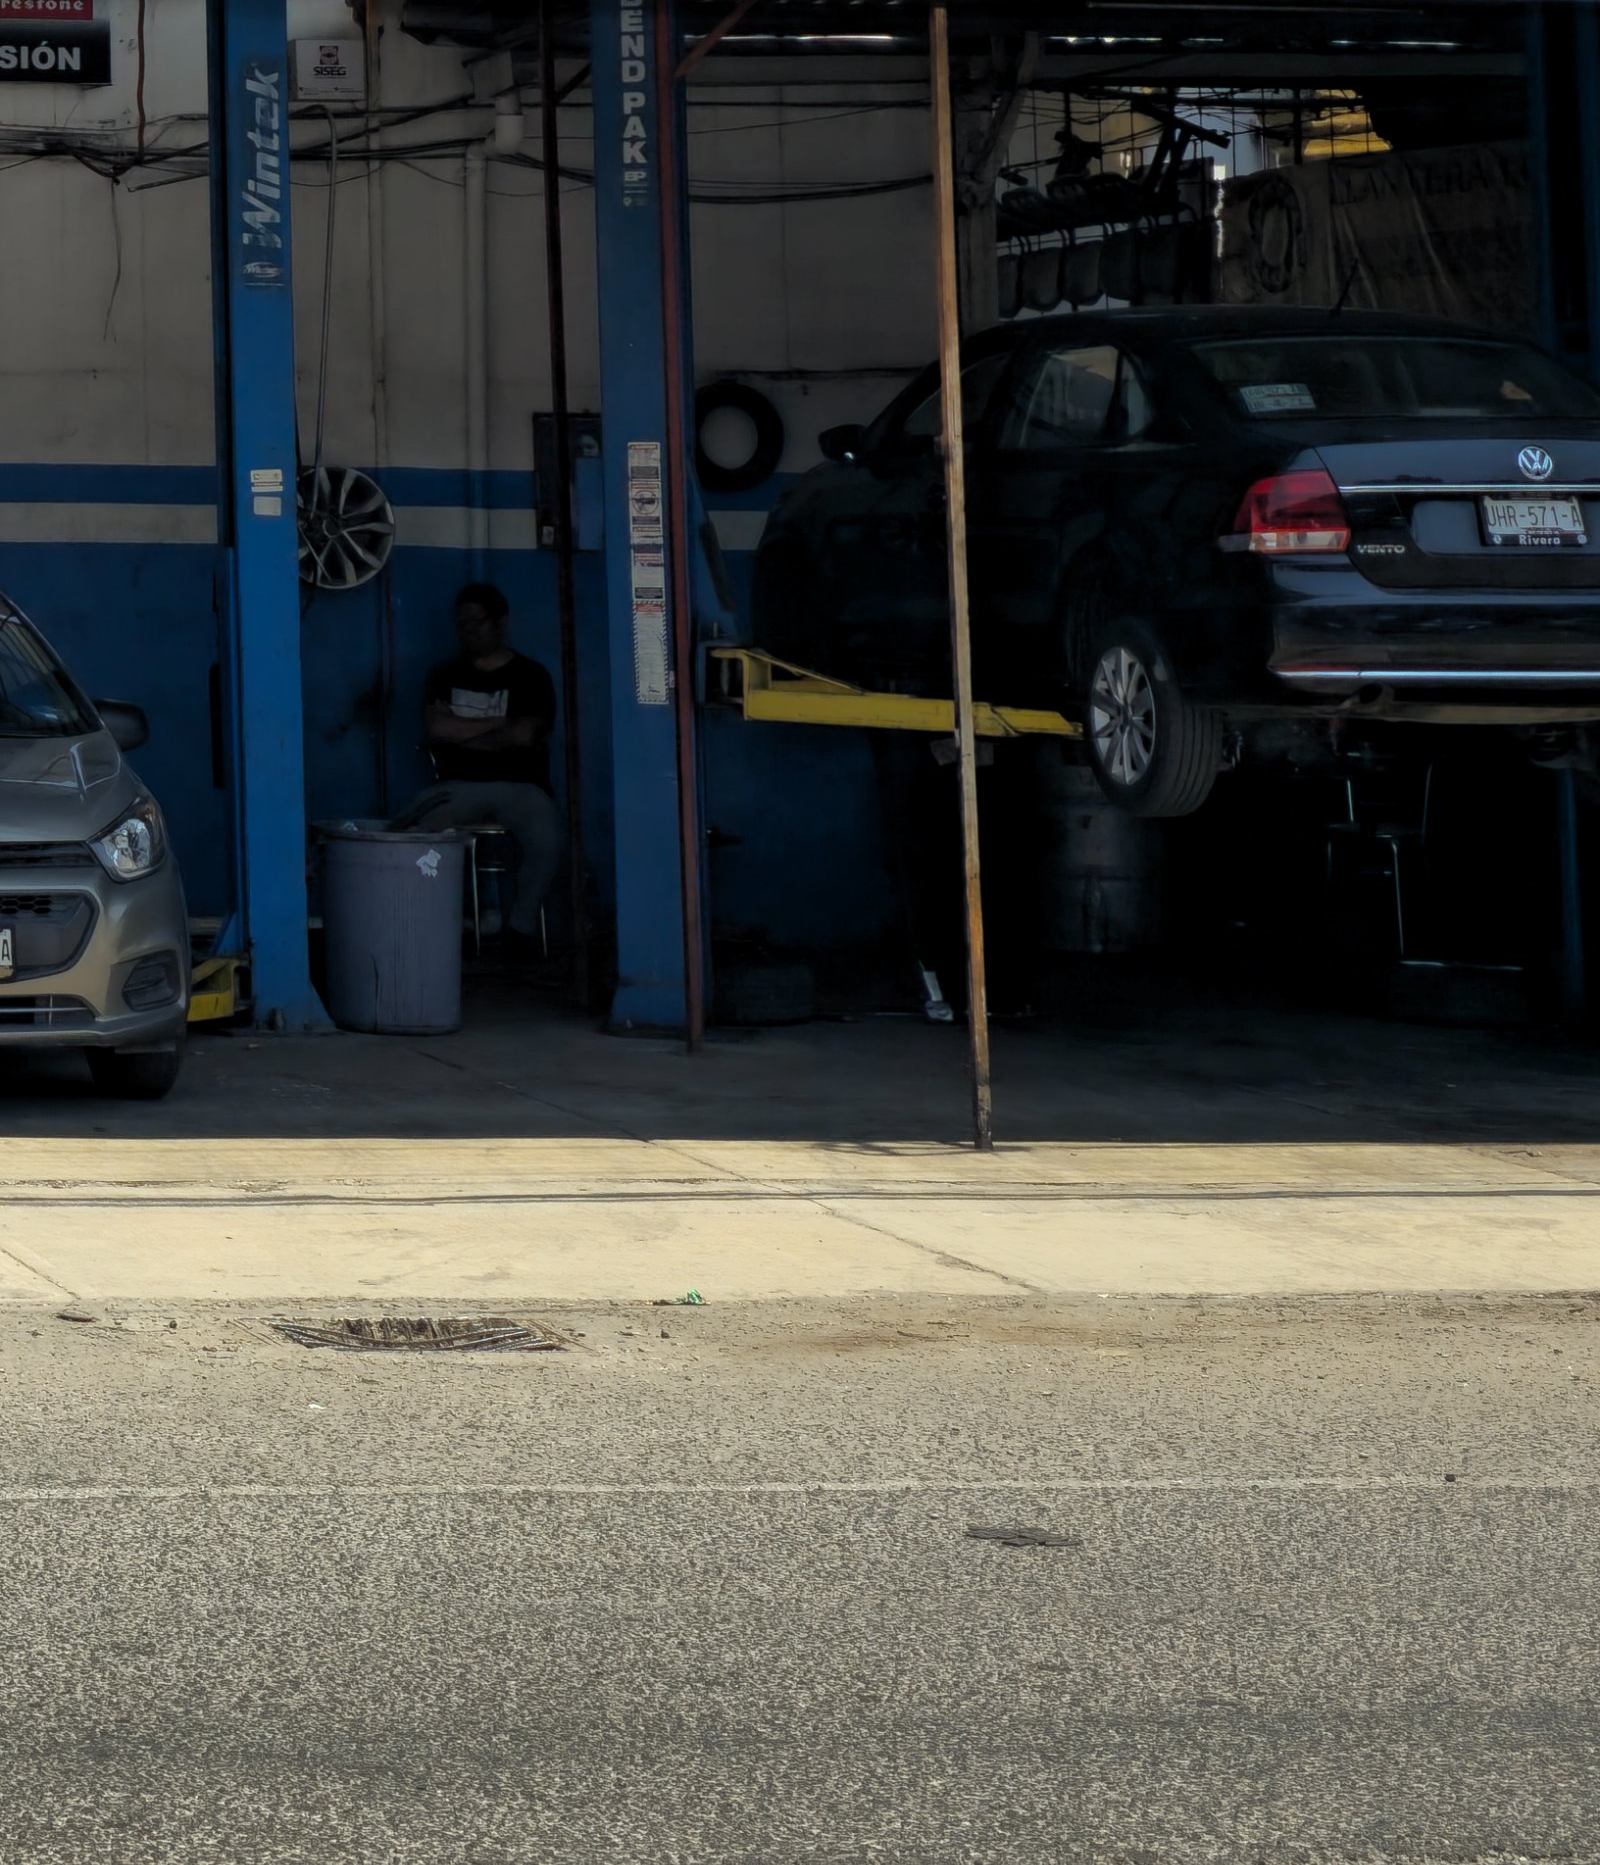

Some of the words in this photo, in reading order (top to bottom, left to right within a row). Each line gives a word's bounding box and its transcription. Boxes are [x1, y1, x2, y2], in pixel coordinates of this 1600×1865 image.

[622, 91, 647, 165] PAK
[1487, 505, 1582, 528] UHR-571-A
[1356, 544, 1405, 554] VENTO
